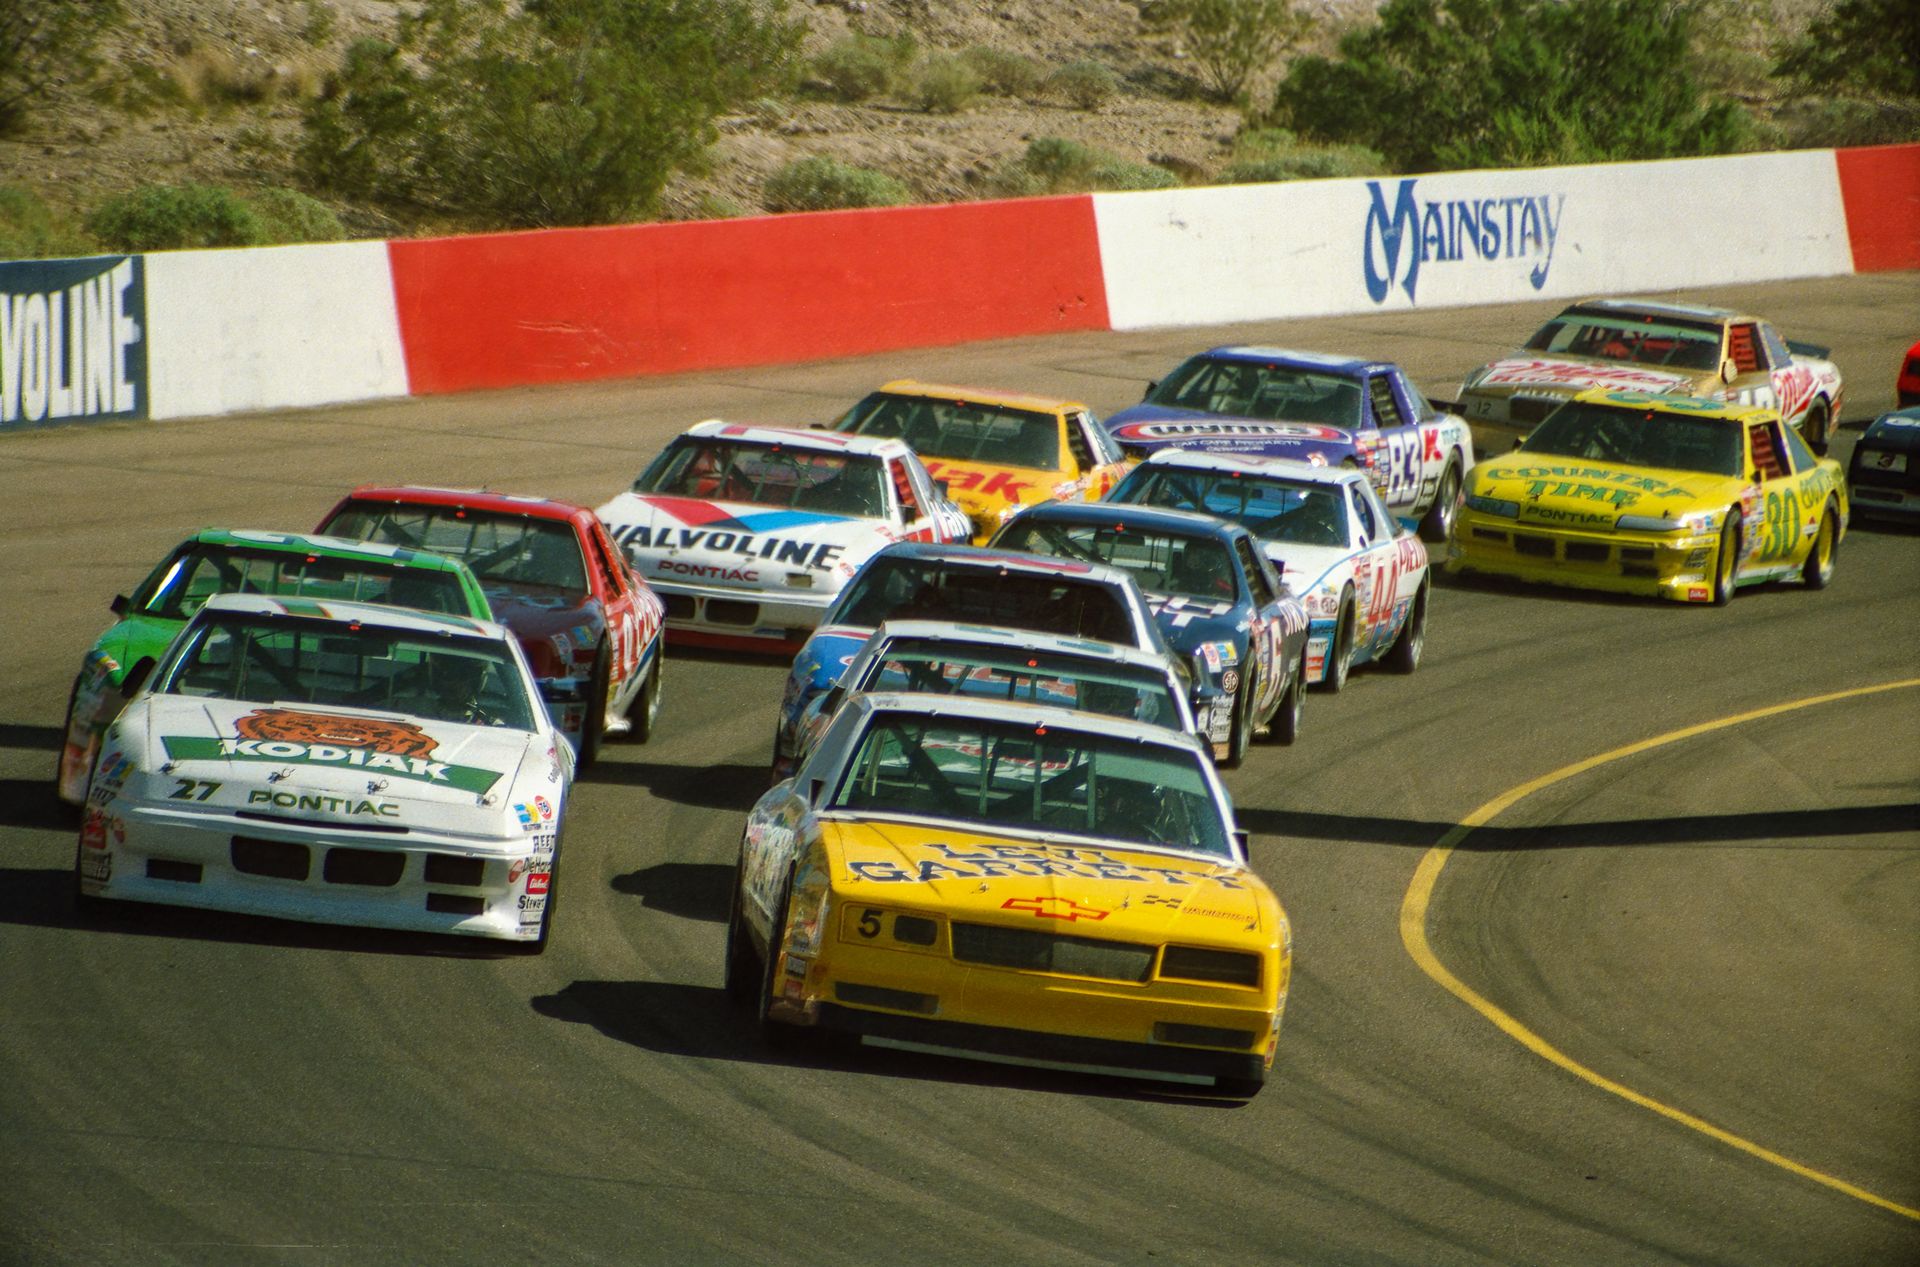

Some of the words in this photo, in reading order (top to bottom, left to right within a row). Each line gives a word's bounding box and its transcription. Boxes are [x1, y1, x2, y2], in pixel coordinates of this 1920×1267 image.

[1364, 180, 1566, 307] MAINSTAY
[0, 257, 140, 424] VOLINE
[1486, 466, 1698, 500] COUNTRY
[1524, 480, 1642, 507] TIME
[1525, 506, 1614, 524] PONTIAC
[658, 559, 760, 583] PONTIAC
[218, 738, 450, 781] KODIAK
[168, 779, 223, 802] 27
[248, 789, 401, 818] PONTIAC
[857, 910, 883, 939] 5
